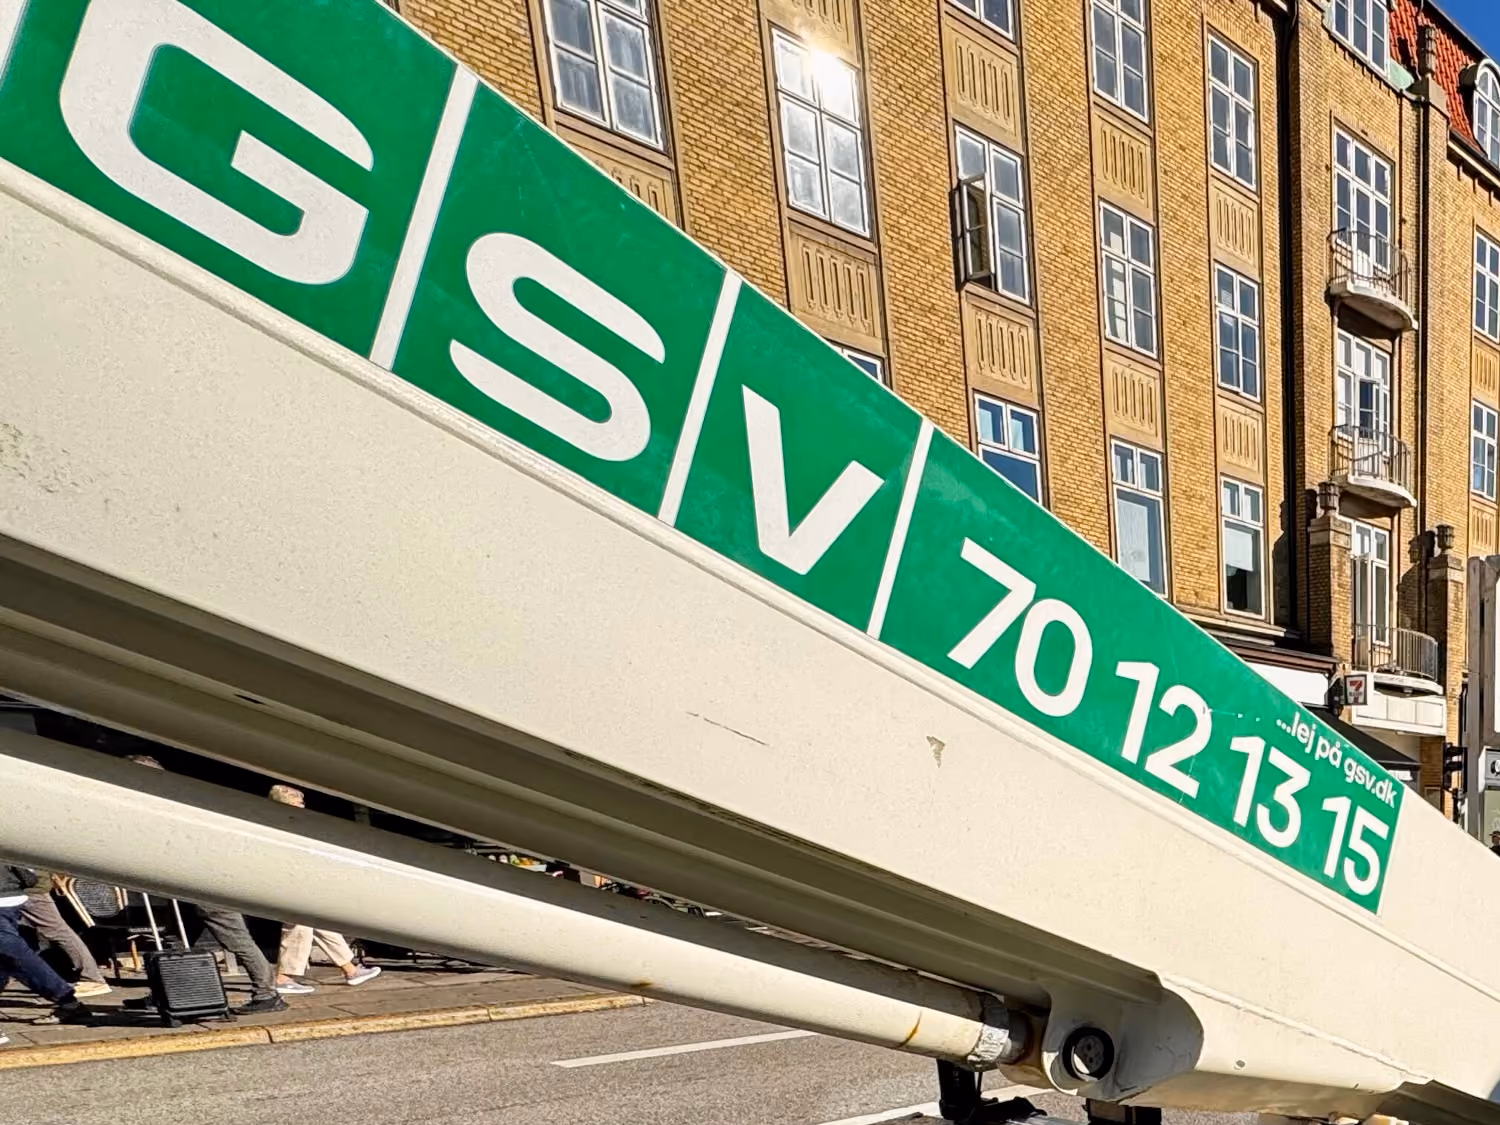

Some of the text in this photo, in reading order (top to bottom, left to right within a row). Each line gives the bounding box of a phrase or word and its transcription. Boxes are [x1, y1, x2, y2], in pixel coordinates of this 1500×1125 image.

[947, 536, 1391, 896] 70 12 13 15
[1315, 736, 1343, 768] på
[1343, 757, 1397, 809] gsv.dk
